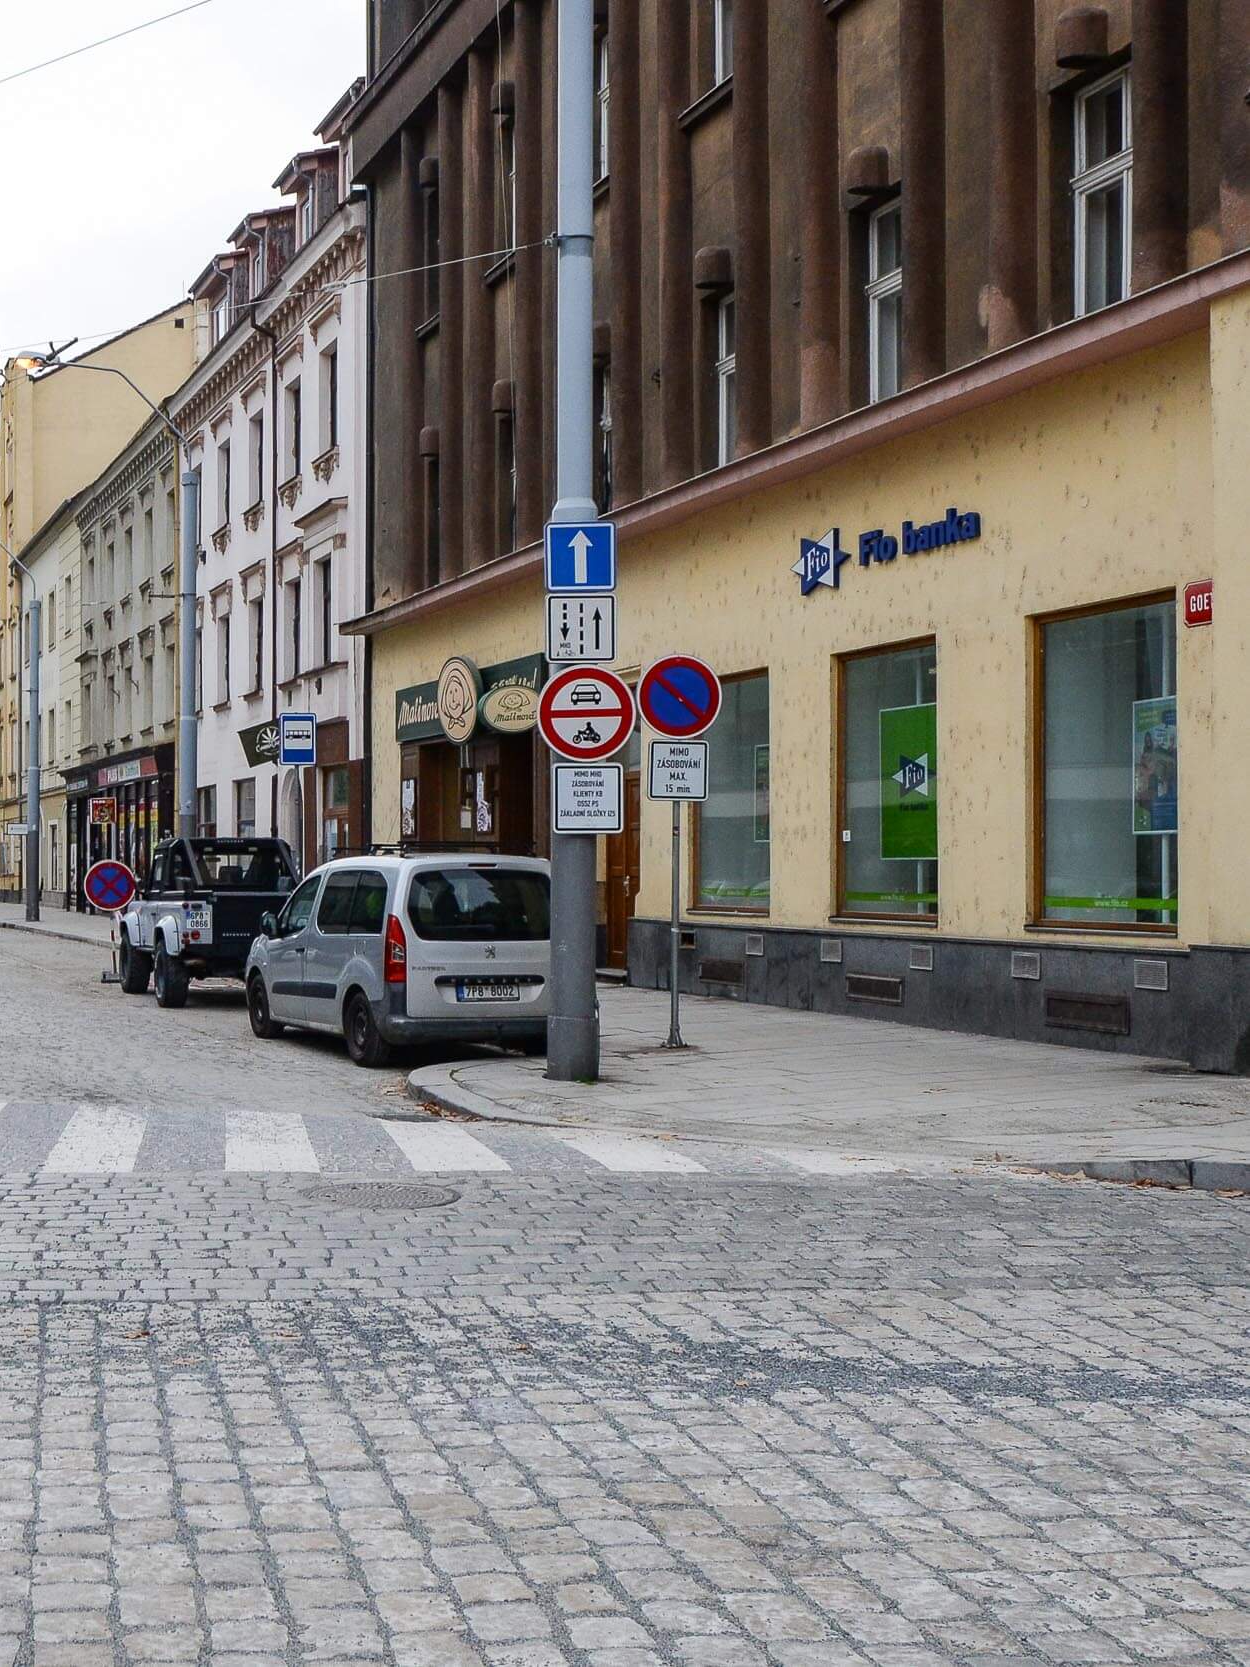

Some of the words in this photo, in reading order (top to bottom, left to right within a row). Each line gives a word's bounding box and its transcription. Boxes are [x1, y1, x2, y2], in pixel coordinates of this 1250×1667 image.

[859, 529, 898, 566] Fio
[902, 508, 980, 555] banka
[806, 546, 828, 582] Fio
[1190, 592, 1213, 612] GOE
[669, 747, 689, 757] MIMO
[657, 757, 701, 769] ZÁSOBOVÁNÍ
[905, 763, 924, 789] Fio
[665, 784, 673, 792] 15
[465, 986, 484, 997] 7P8
[490, 985, 514, 997] 8002
